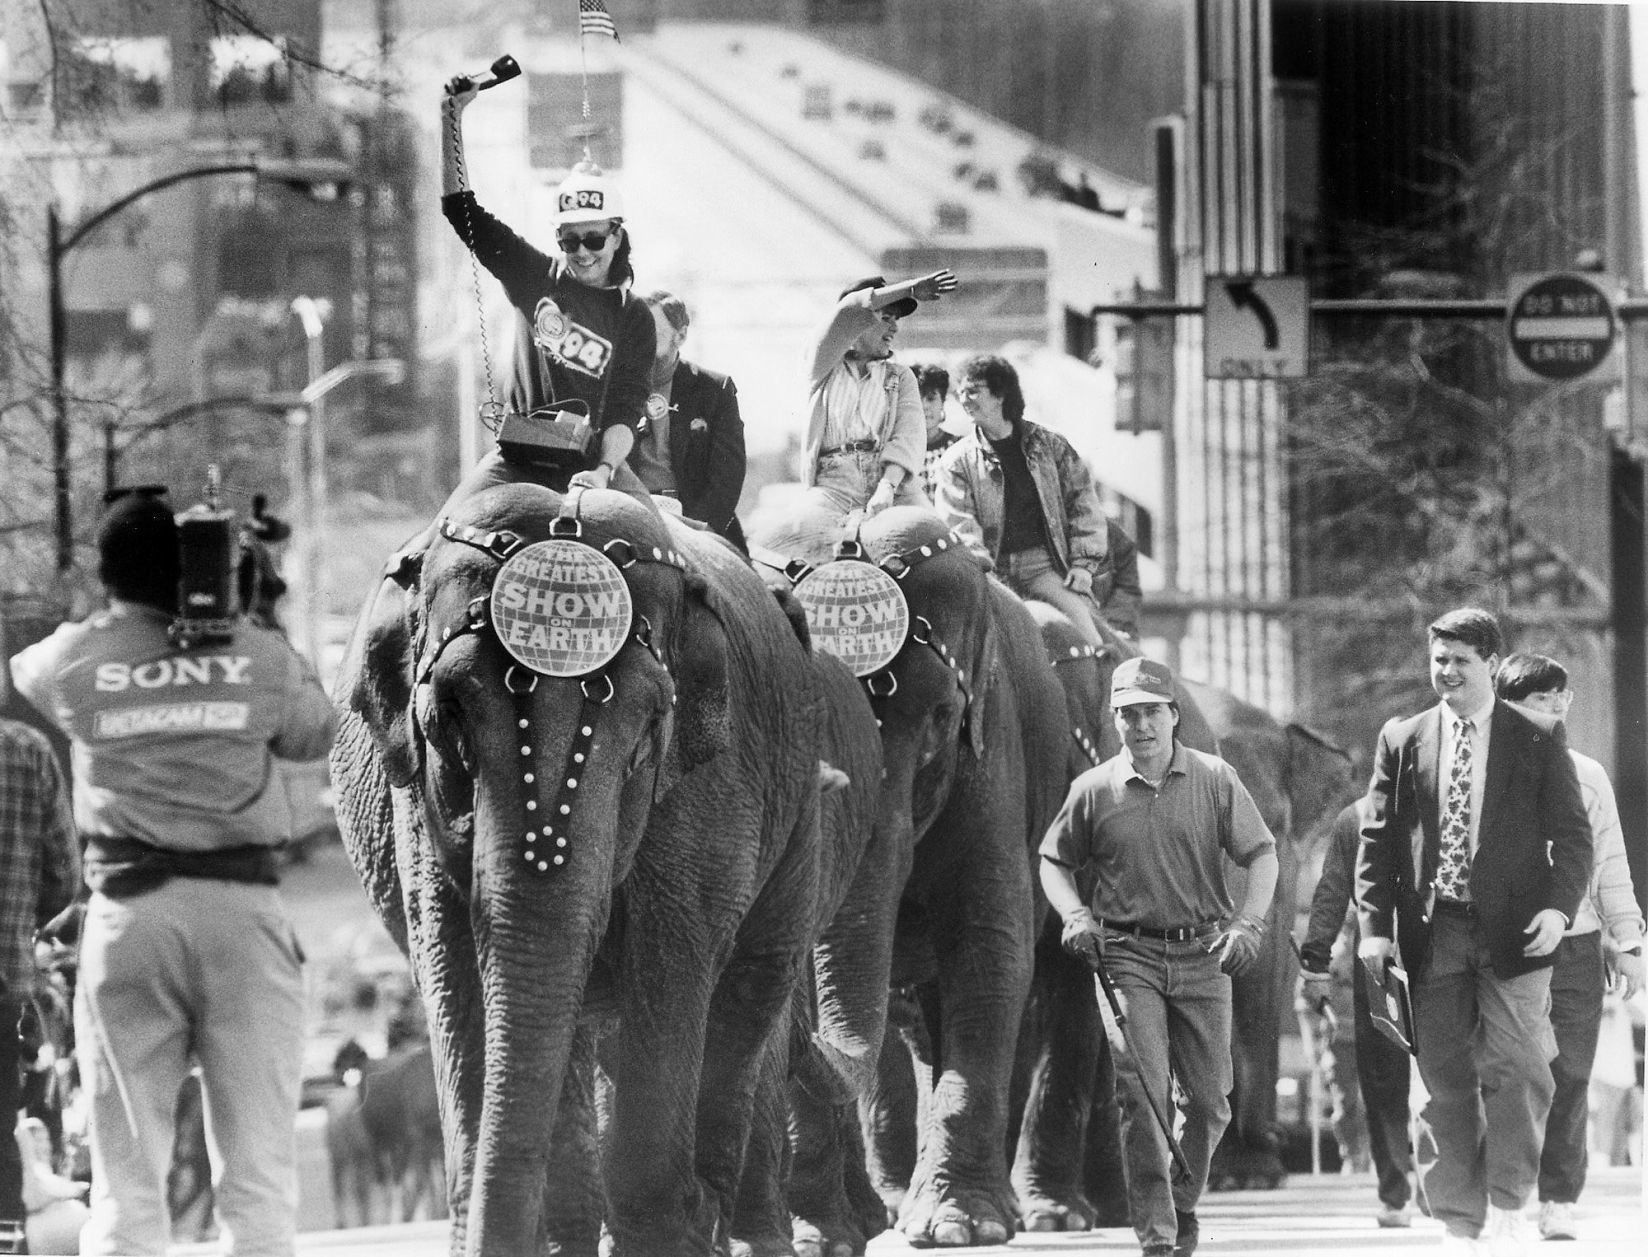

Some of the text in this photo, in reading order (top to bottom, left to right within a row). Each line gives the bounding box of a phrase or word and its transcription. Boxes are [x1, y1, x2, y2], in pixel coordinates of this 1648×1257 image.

[1523, 294, 1600, 315] DO NOT
[1530, 341, 1594, 361] ENTER
[512, 557, 612, 583] GREATEST
[500, 582, 620, 618] SHOW
[550, 618, 573, 628] ON
[838, 627, 858, 636] ON
[508, 620, 612, 653] EARTH
[95, 655, 252, 692] SONY
